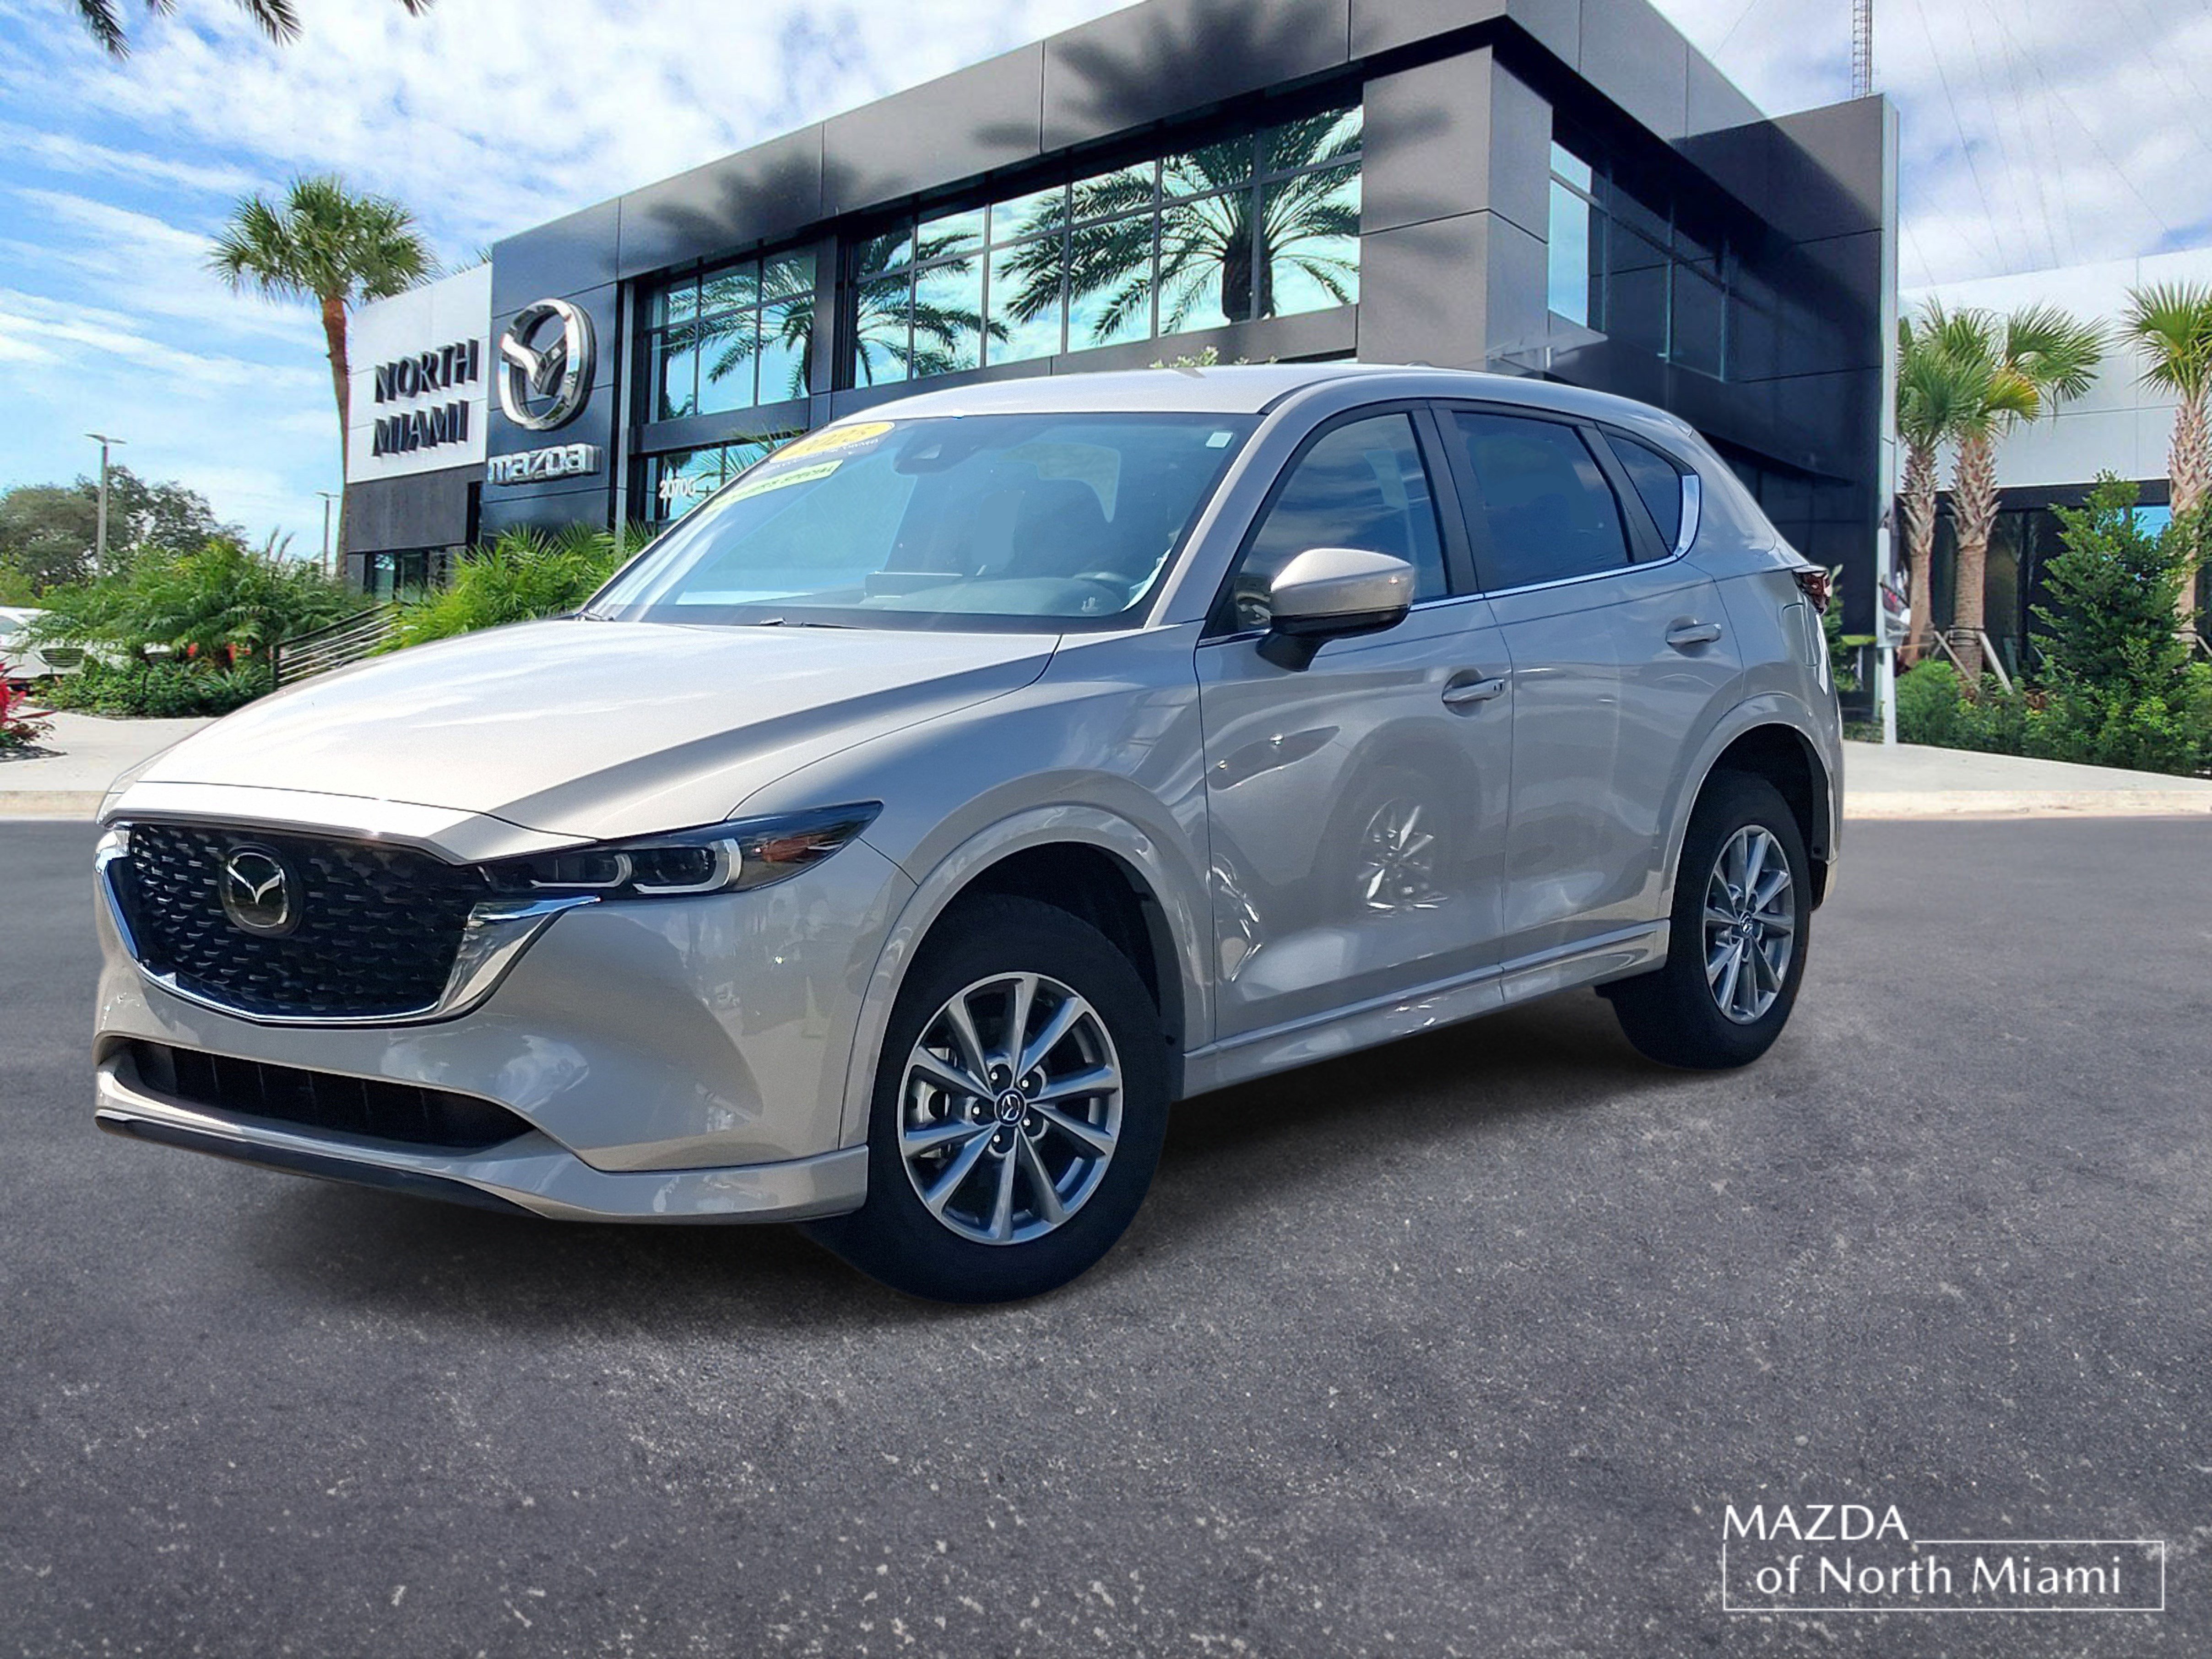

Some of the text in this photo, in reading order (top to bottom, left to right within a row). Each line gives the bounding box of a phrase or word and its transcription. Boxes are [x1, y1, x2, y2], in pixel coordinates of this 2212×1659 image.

[374, 338, 479, 403] NORTH
[372, 400, 469, 456] MIAMI
[487, 443, 602, 486] mazda
[659, 478, 696, 499] 20700
